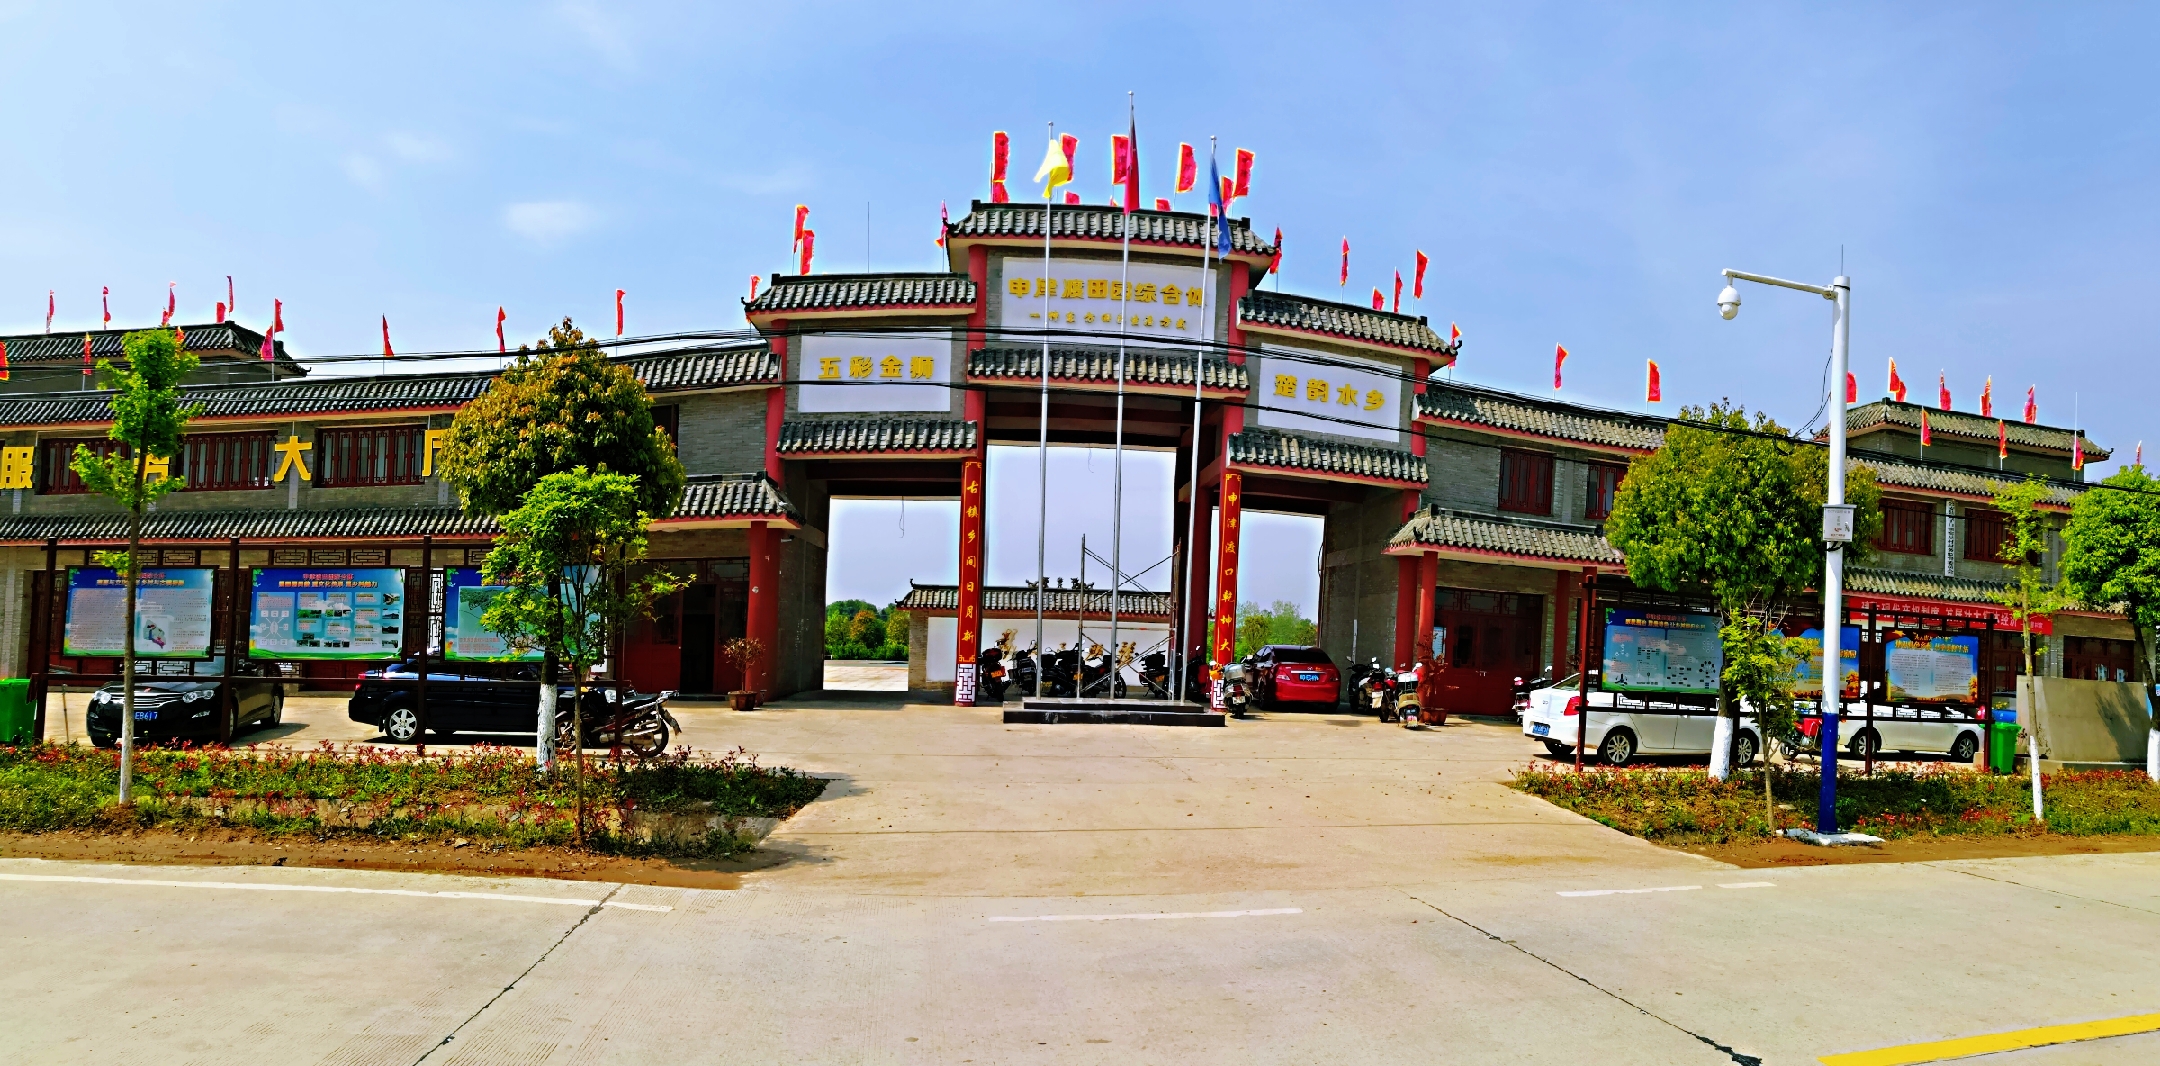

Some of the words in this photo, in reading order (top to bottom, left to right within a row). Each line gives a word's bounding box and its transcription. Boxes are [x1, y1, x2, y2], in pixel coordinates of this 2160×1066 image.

[1008, 277, 1207, 307] 申津渡田园综合体
[818, 354, 935, 380] 五彩金狮
